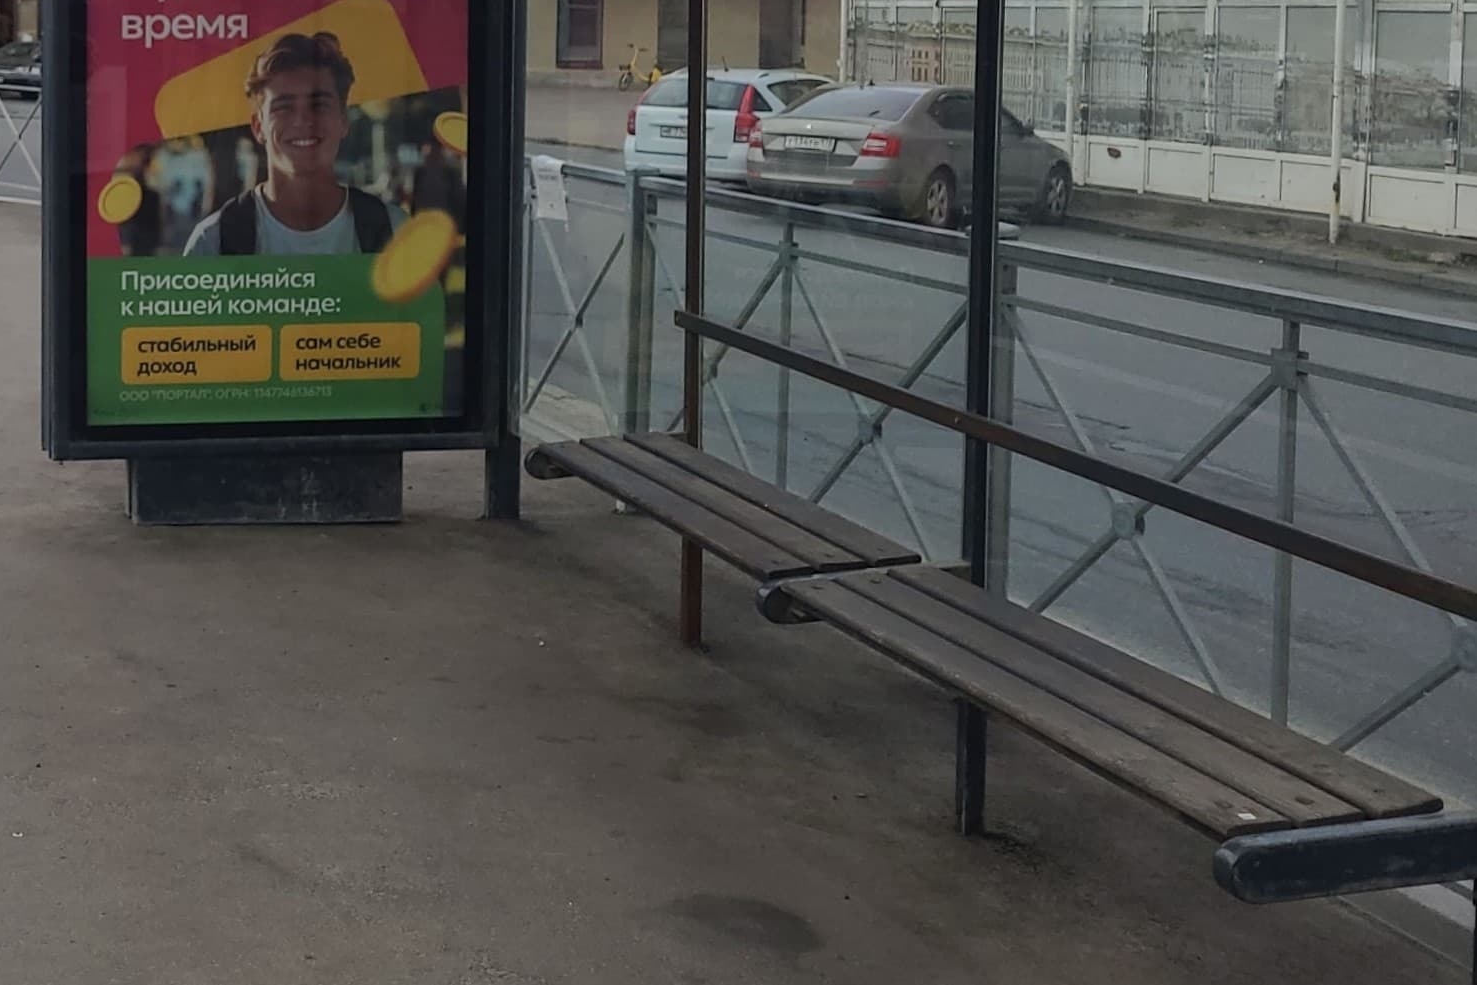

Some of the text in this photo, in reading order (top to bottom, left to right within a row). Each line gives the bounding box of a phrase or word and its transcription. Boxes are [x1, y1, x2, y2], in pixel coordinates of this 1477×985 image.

[122, 14, 249, 48] время
[121, 268, 316, 295] Присоединяйся
[121, 294, 341, 316] к нашей команде:
[137, 335, 257, 354] стабильный
[295, 333, 382, 350] сам себе
[137, 361, 198, 377] доход
[295, 355, 402, 371] начальник
[120, 390, 149, 402] ООО
